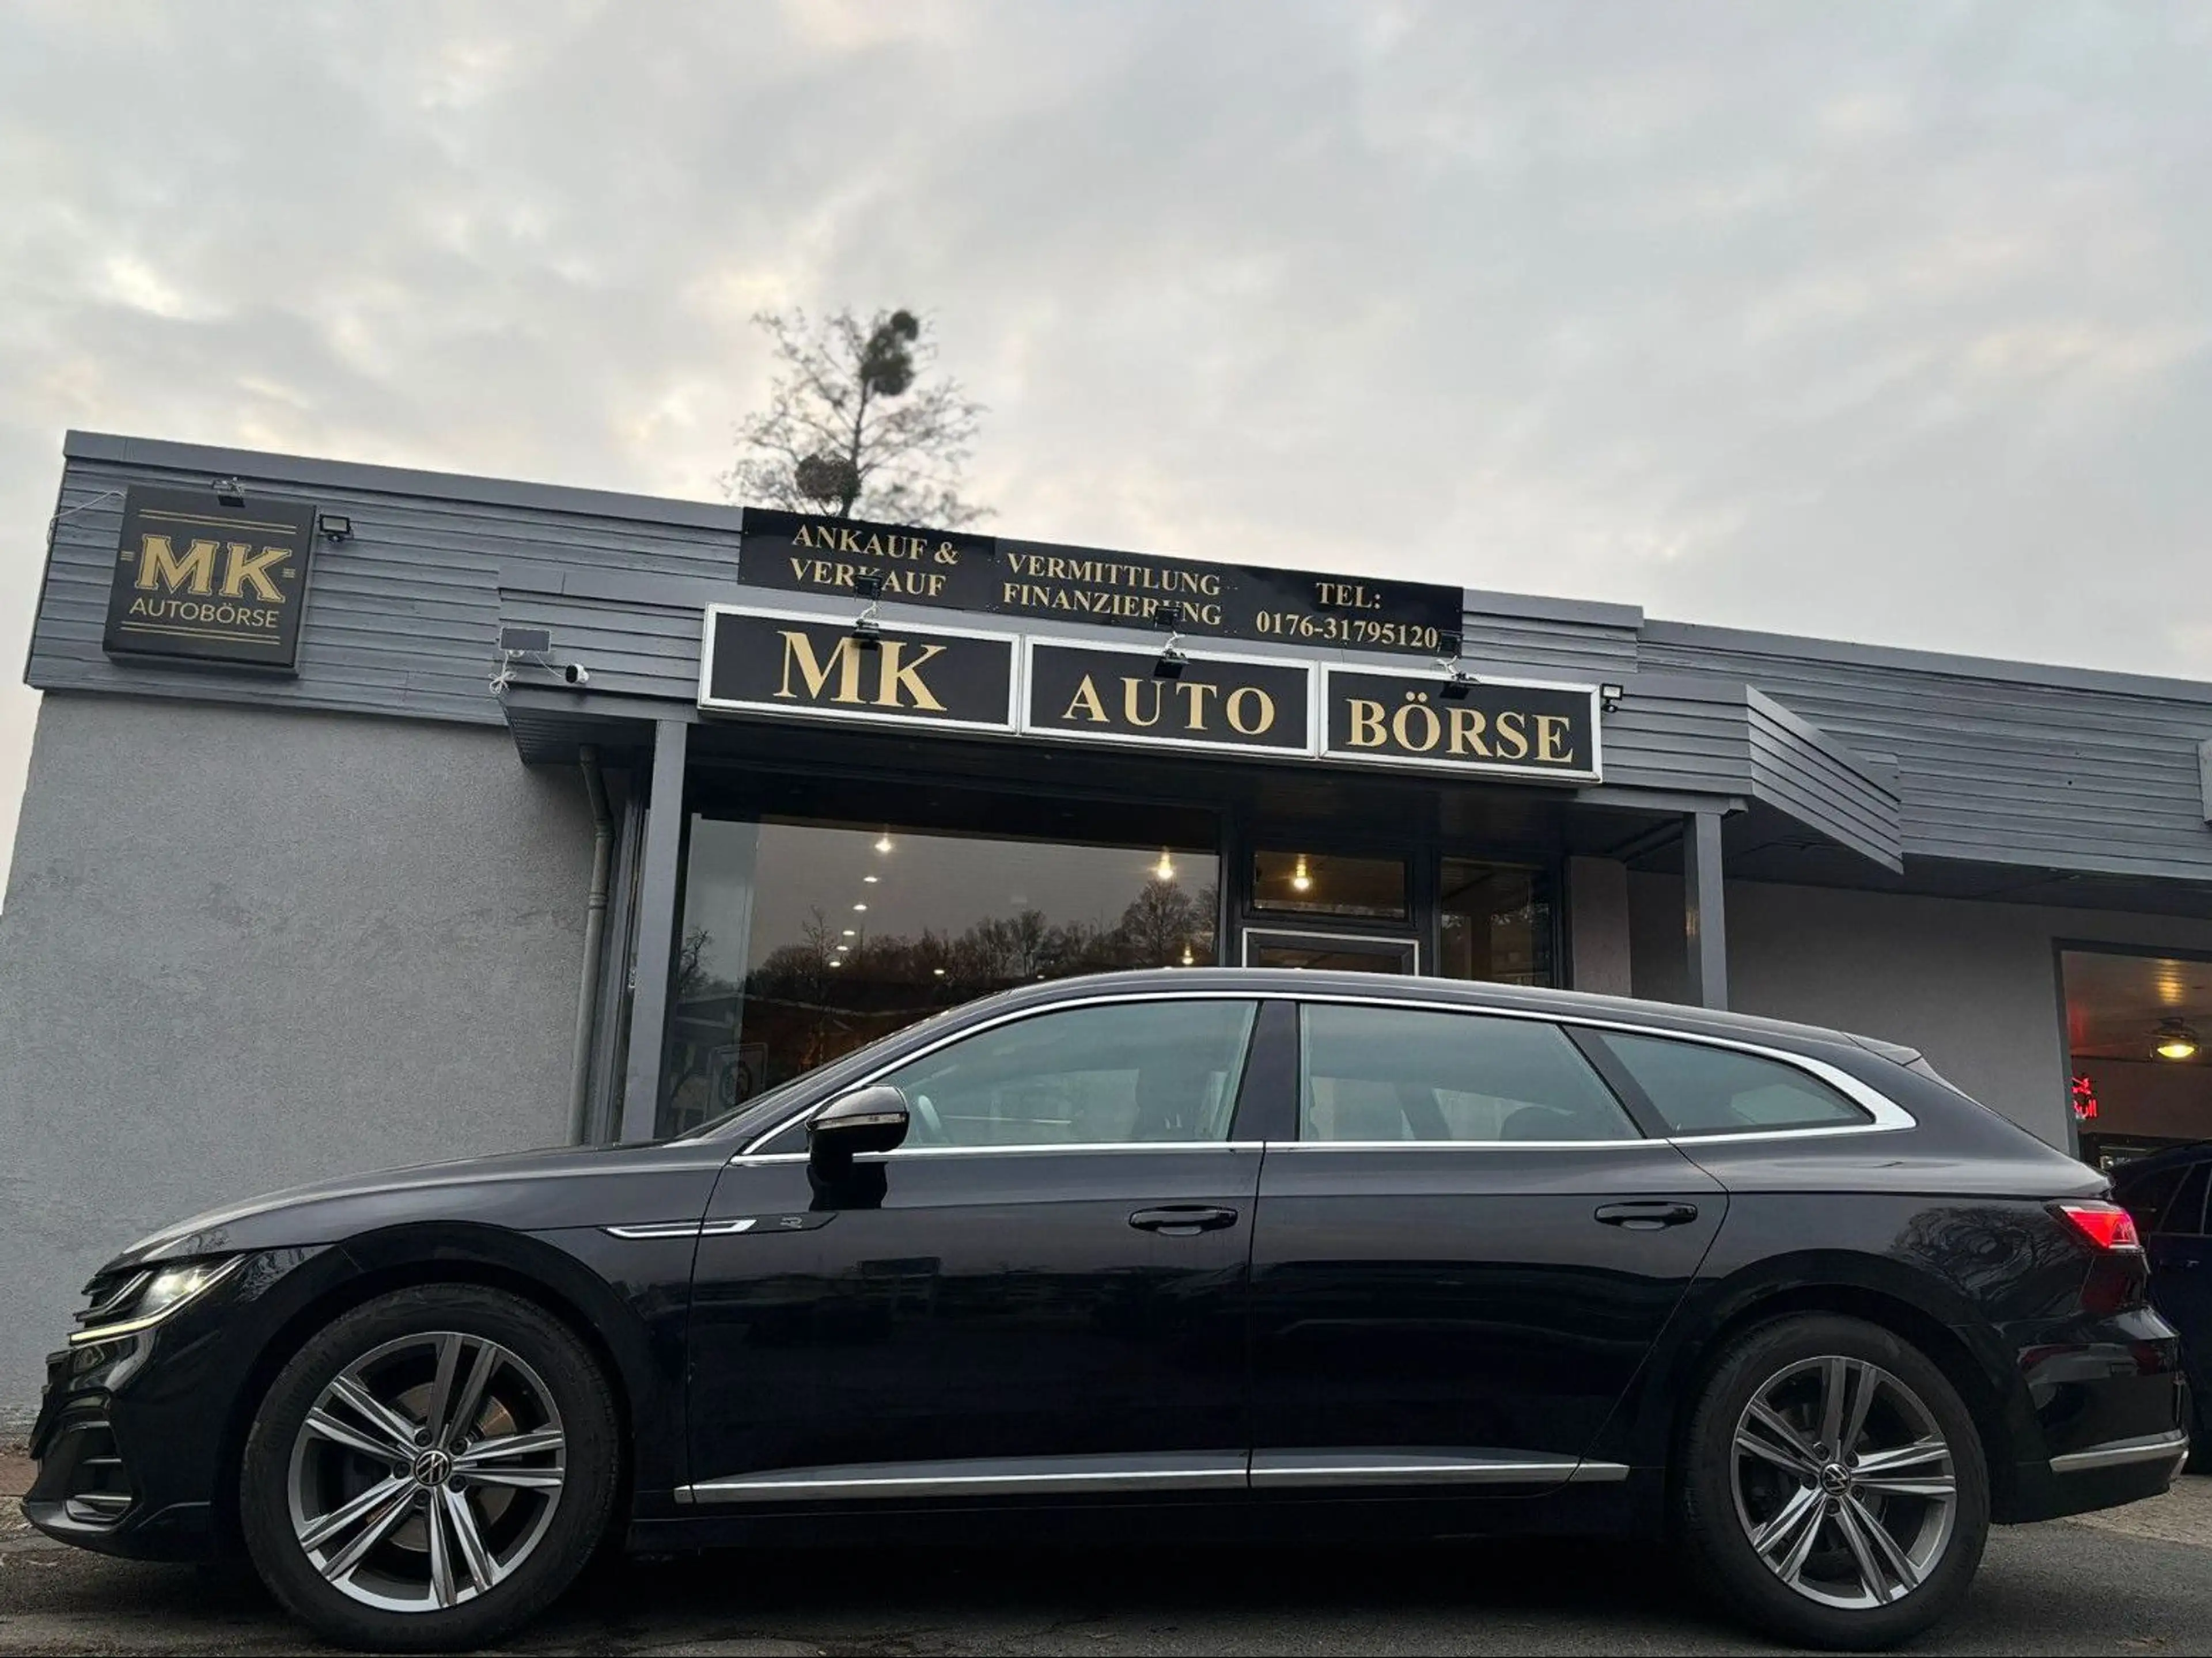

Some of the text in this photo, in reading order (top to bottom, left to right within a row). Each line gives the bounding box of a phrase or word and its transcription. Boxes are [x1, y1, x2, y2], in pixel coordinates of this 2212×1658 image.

[791, 523, 959, 565] ANKAUF &
[135, 534, 291, 604] MK
[1007, 553, 1221, 595] VERMITTLUNG
[129, 597, 280, 628] AUTOBÖRSE
[1316, 582, 1381, 609] TEL:
[1256, 610, 1438, 648] 0176-31795120
[772, 631, 1573, 764] MK AUTO BÖRSE
